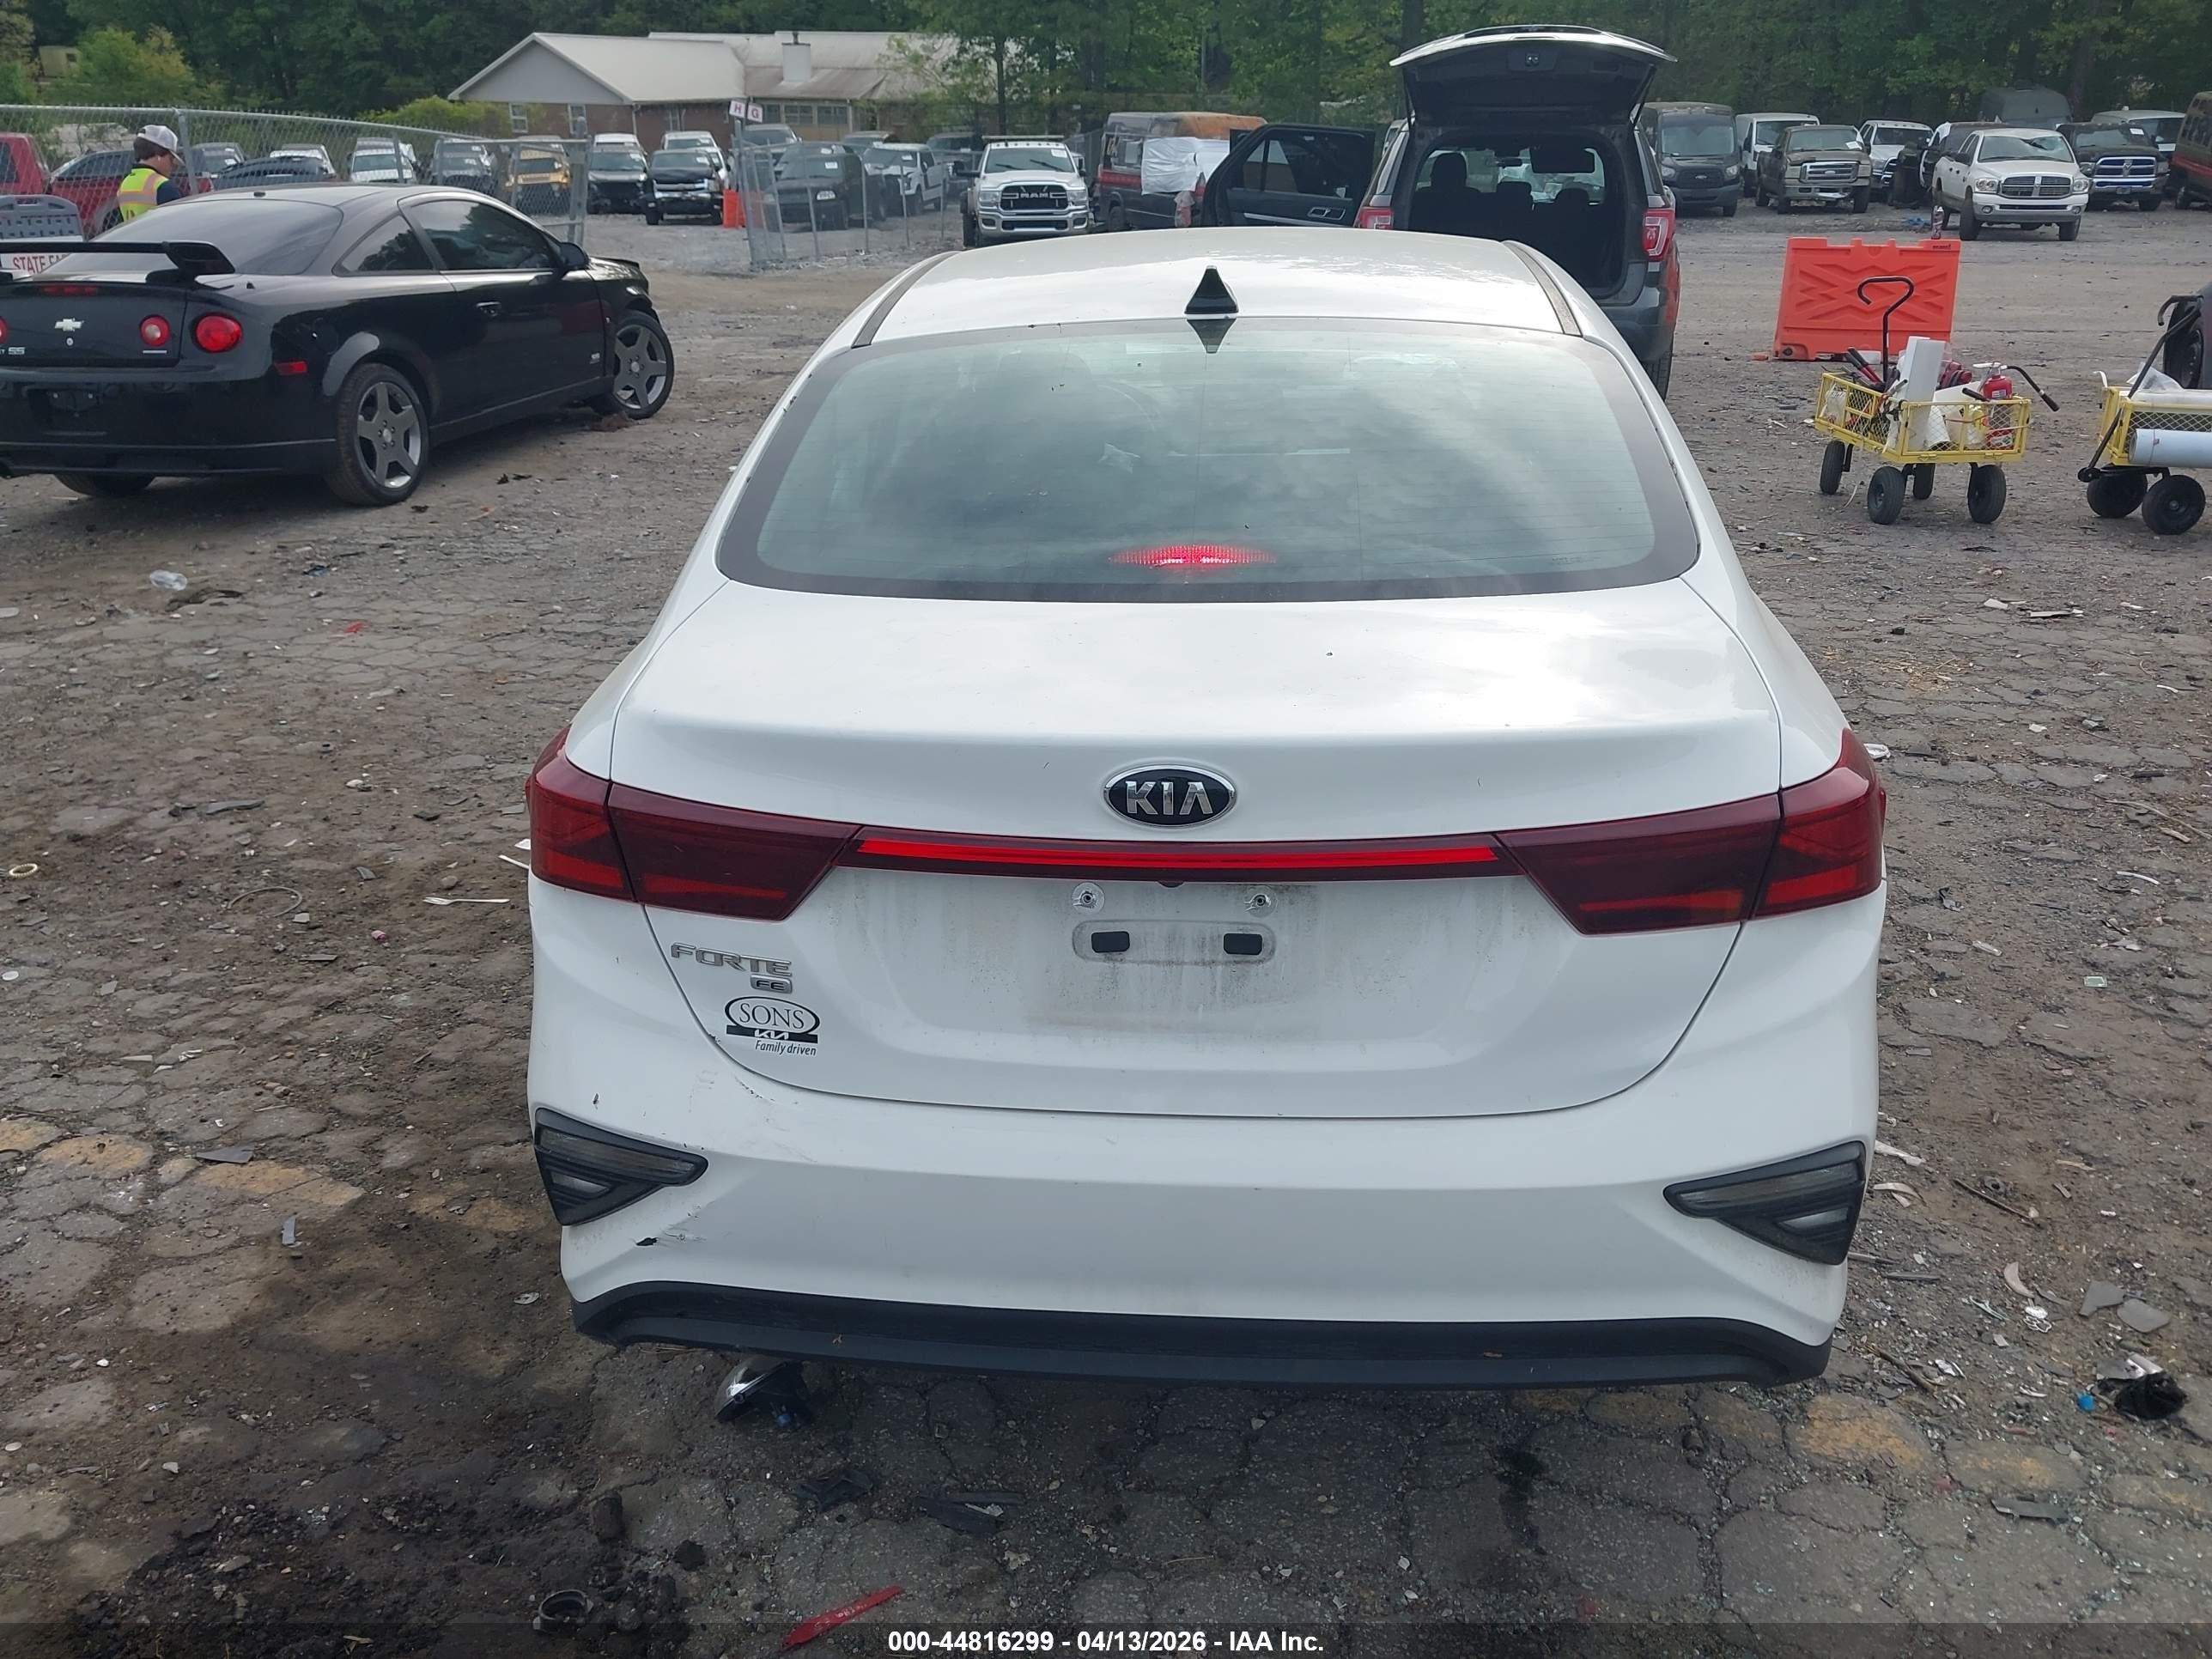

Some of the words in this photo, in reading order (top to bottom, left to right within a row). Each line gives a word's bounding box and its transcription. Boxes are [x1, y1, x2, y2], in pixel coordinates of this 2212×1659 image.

[14, 256, 46, 274] STATE
[1125, 781, 1213, 815] KIA
[671, 942, 793, 976] FORTE
[756, 979, 786, 991] FE
[739, 1002, 805, 1030] SONS
[755, 1040, 787, 1055] Family
[787, 1042, 817, 1056] driven
